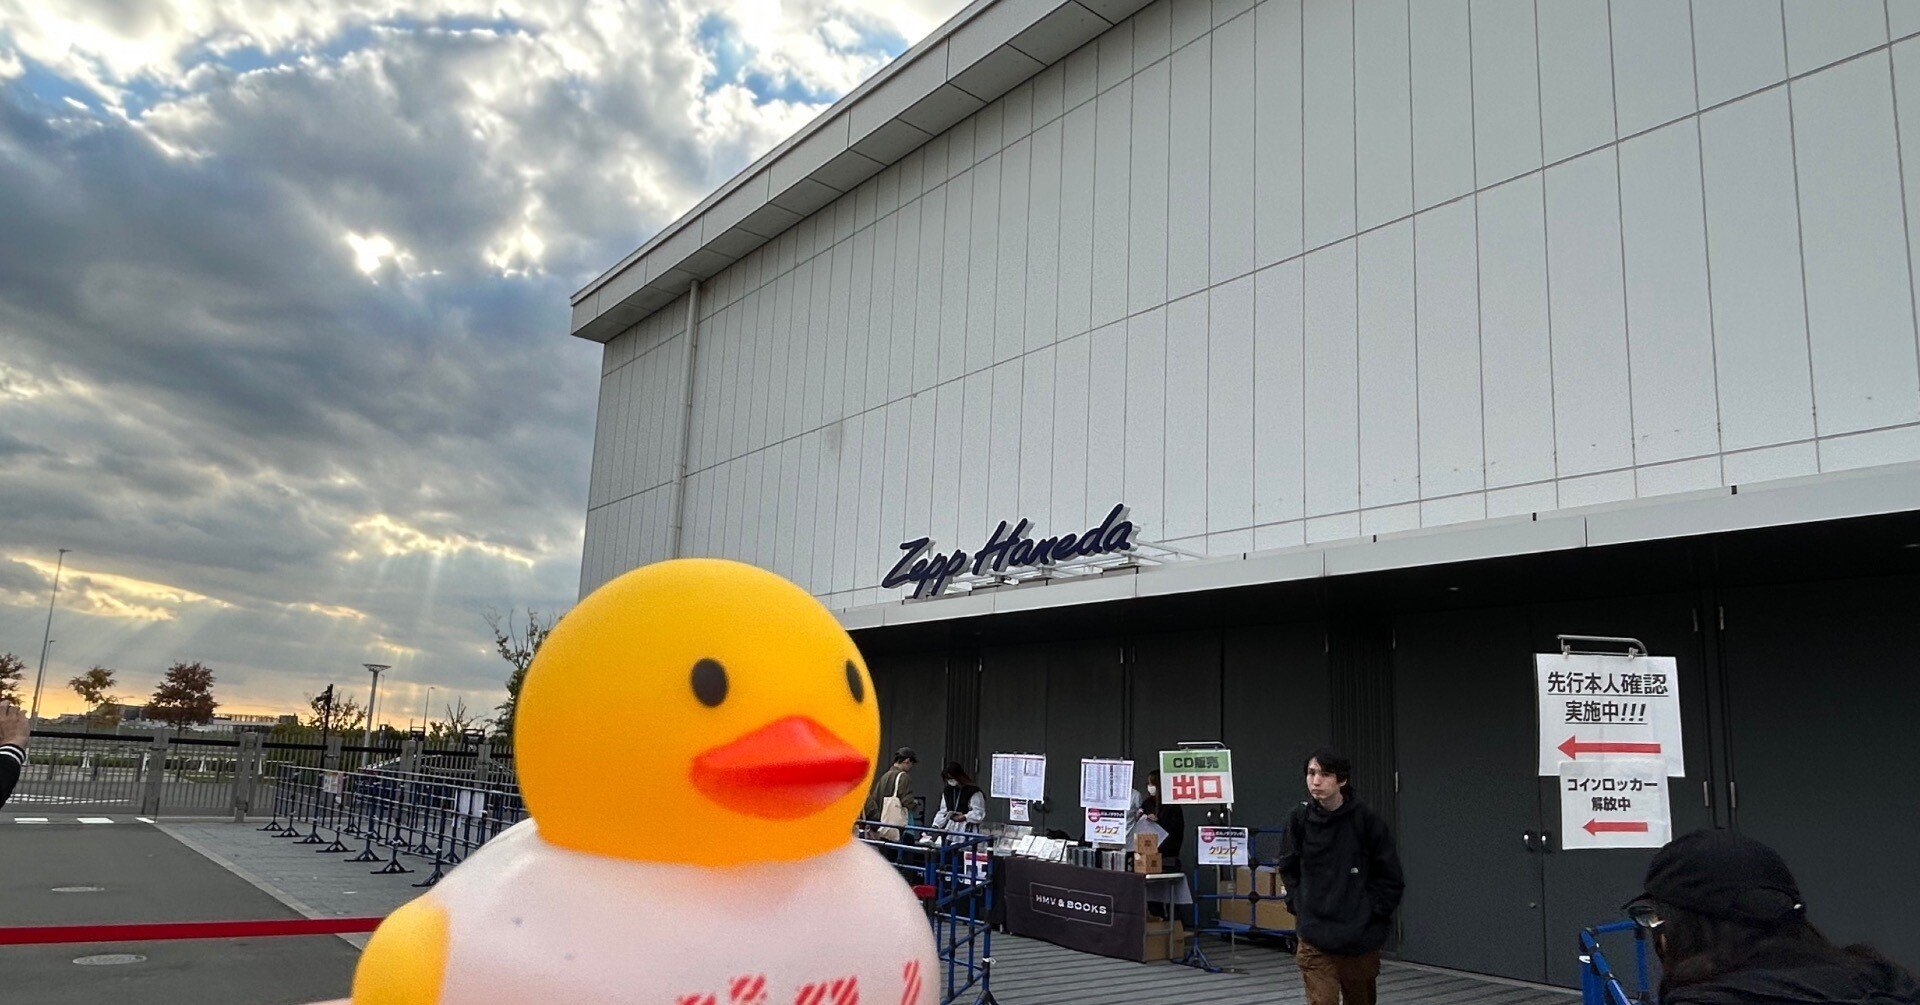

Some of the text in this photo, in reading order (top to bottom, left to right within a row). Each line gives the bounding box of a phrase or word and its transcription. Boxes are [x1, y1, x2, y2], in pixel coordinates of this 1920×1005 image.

[881, 503, 1134, 599] Zepp Haneda
[1548, 671, 1668, 694] 先行本人確認
[1565, 700, 1646, 722] 実施中!!!
[1173, 756, 1219, 769] CD販売
[1172, 775, 1223, 800] 出口
[1567, 778, 1658, 792] コインロッカー
[1591, 797, 1631, 812] 解放中
[1036, 895, 1107, 914] HMV & BOOKS
